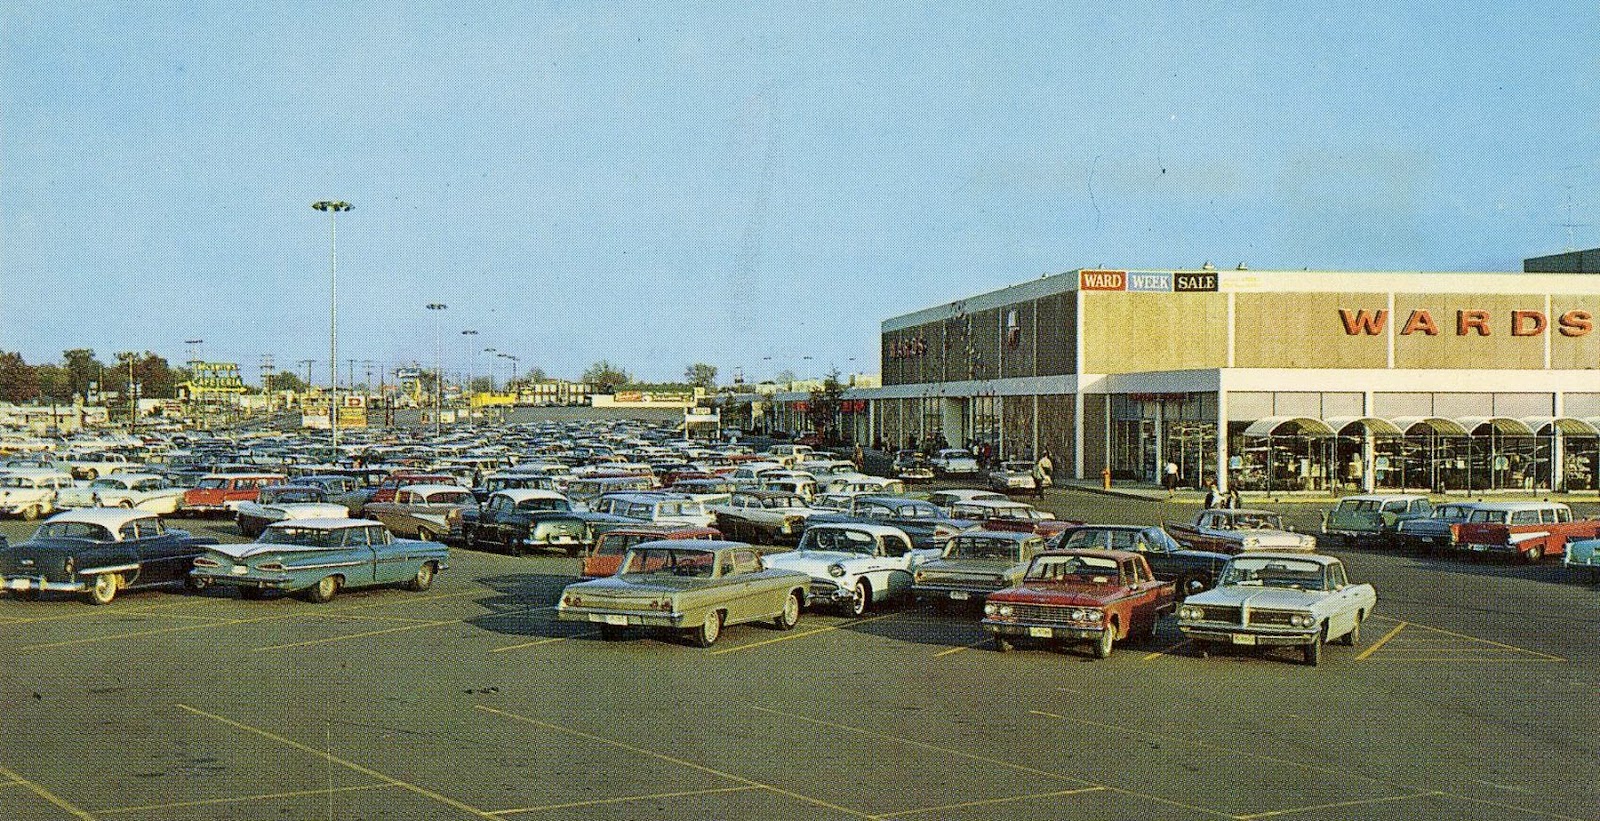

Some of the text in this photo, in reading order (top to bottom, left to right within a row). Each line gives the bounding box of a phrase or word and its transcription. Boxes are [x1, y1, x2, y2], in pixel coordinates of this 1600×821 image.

[1084, 274, 1121, 288] WARD
[1132, 275, 1169, 289] WEEK
[1178, 276, 1215, 289] SALE
[1338, 309, 1593, 337] WARDS
[192, 377, 243, 388] CAFETERIA
